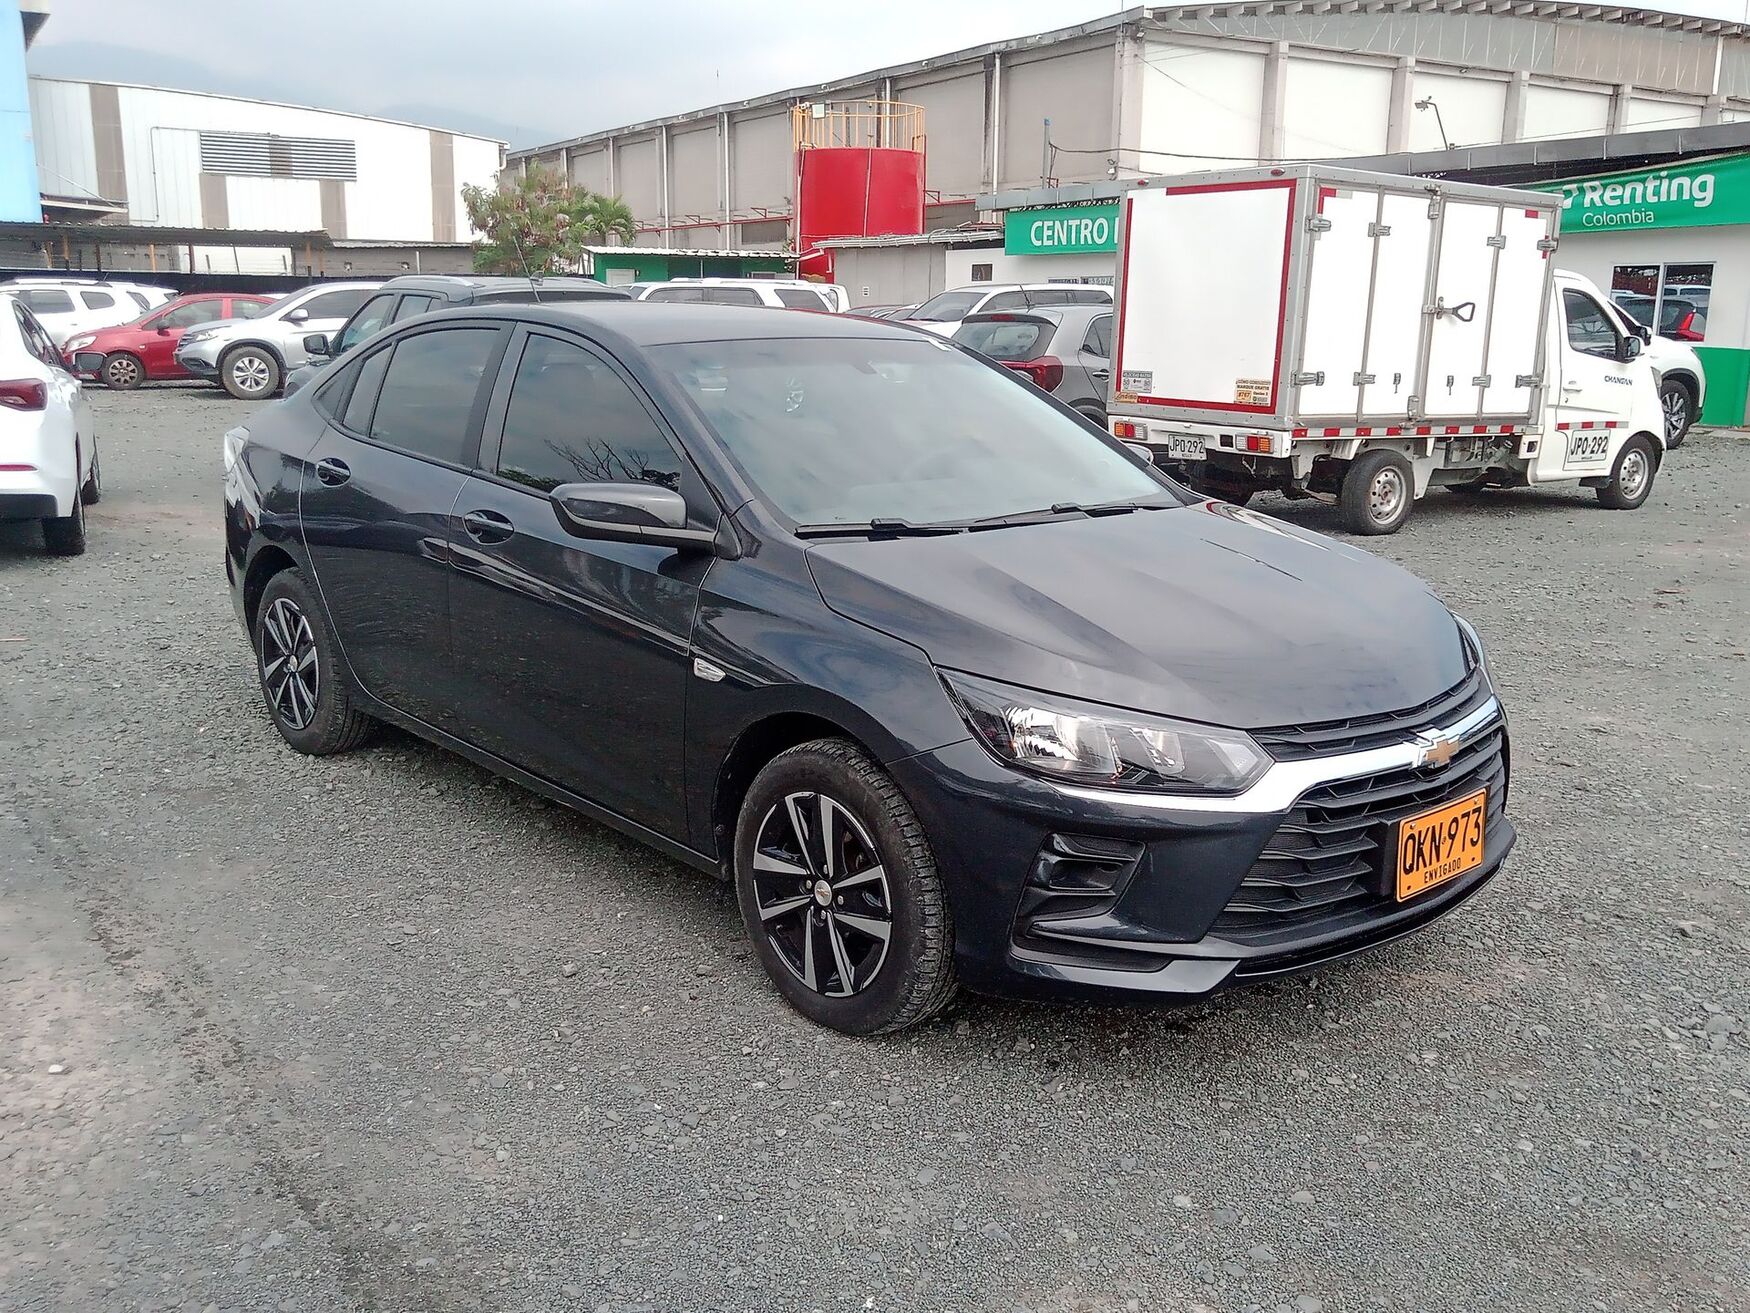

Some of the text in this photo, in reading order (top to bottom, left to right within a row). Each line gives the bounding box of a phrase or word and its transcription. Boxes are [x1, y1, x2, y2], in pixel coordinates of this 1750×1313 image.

[1583, 171, 1715, 208] Renting
[1030, 217, 1108, 246] CENTRO
[1582, 208, 1655, 227] Colombia
[1423, 857, 1462, 884] ENVIGADO
